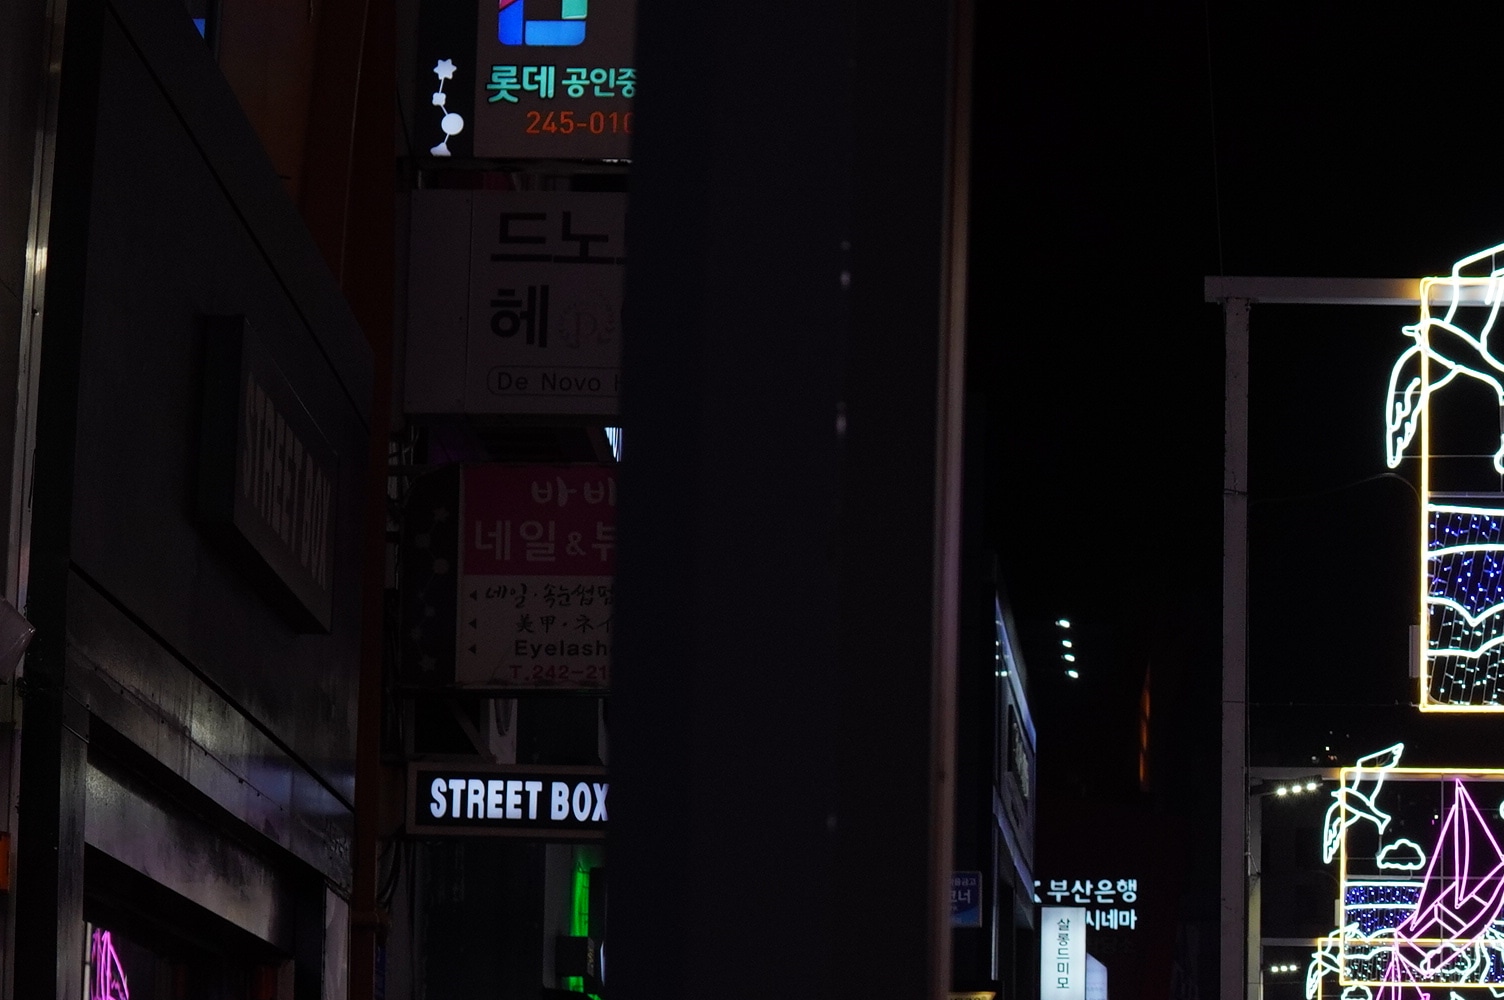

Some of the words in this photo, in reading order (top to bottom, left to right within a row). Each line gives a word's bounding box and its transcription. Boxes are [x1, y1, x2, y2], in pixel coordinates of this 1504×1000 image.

[485, 65, 556, 103] 롯데
[490, 211, 625, 264] 드노
[490, 285, 549, 347] 헤
[498, 372, 528, 391] De
[541, 372, 601, 391] Novo
[243, 371, 303, 553] STREET
[514, 640, 608, 659] Eyelash
[430, 777, 543, 820] STREET
[551, 781, 610, 822] BOX
[1047, 879, 1138, 904] 부산은행
[1085, 908, 1138, 931] 시네마
[1056, 917, 1071, 989] 살롱드미모
